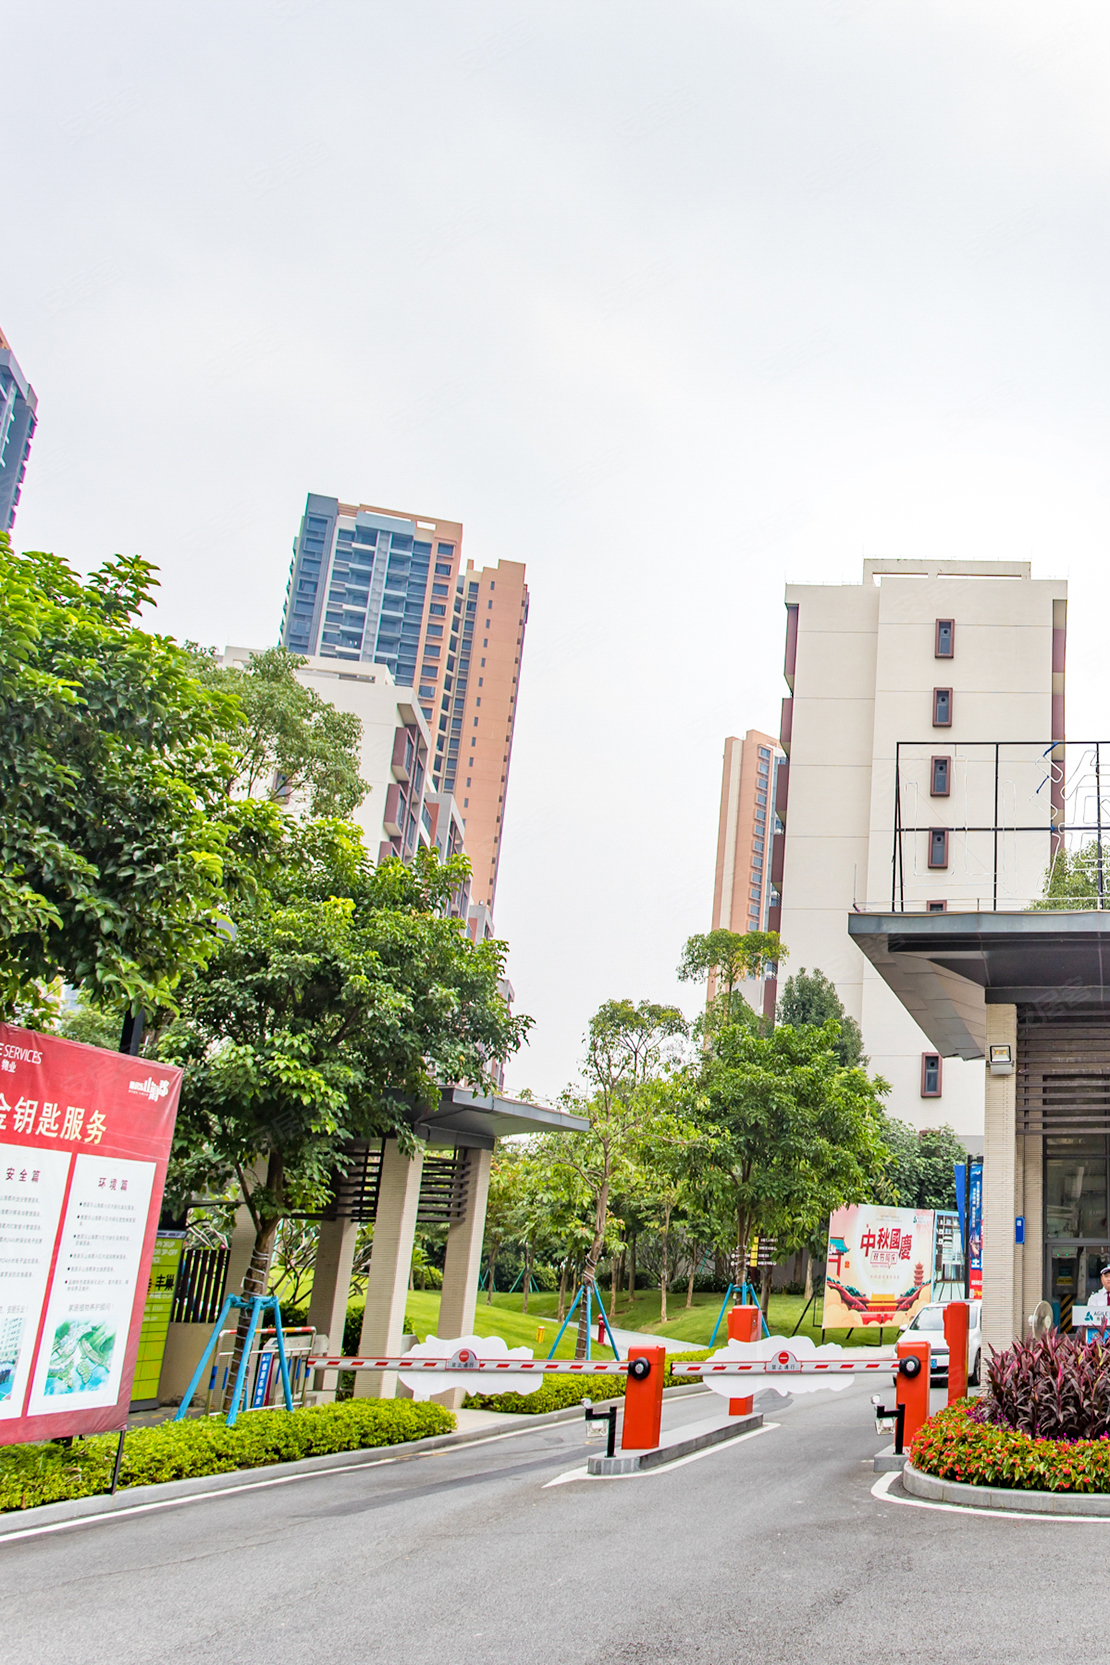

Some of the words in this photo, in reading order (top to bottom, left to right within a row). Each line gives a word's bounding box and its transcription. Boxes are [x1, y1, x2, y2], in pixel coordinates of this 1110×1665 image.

[3, 1044, 43, 1065] SERVICES
[5, 1167, 41, 1183] 安全篇
[98, 1177, 129, 1191] 环境篇
[155, 1273, 175, 1291] 丰巢
